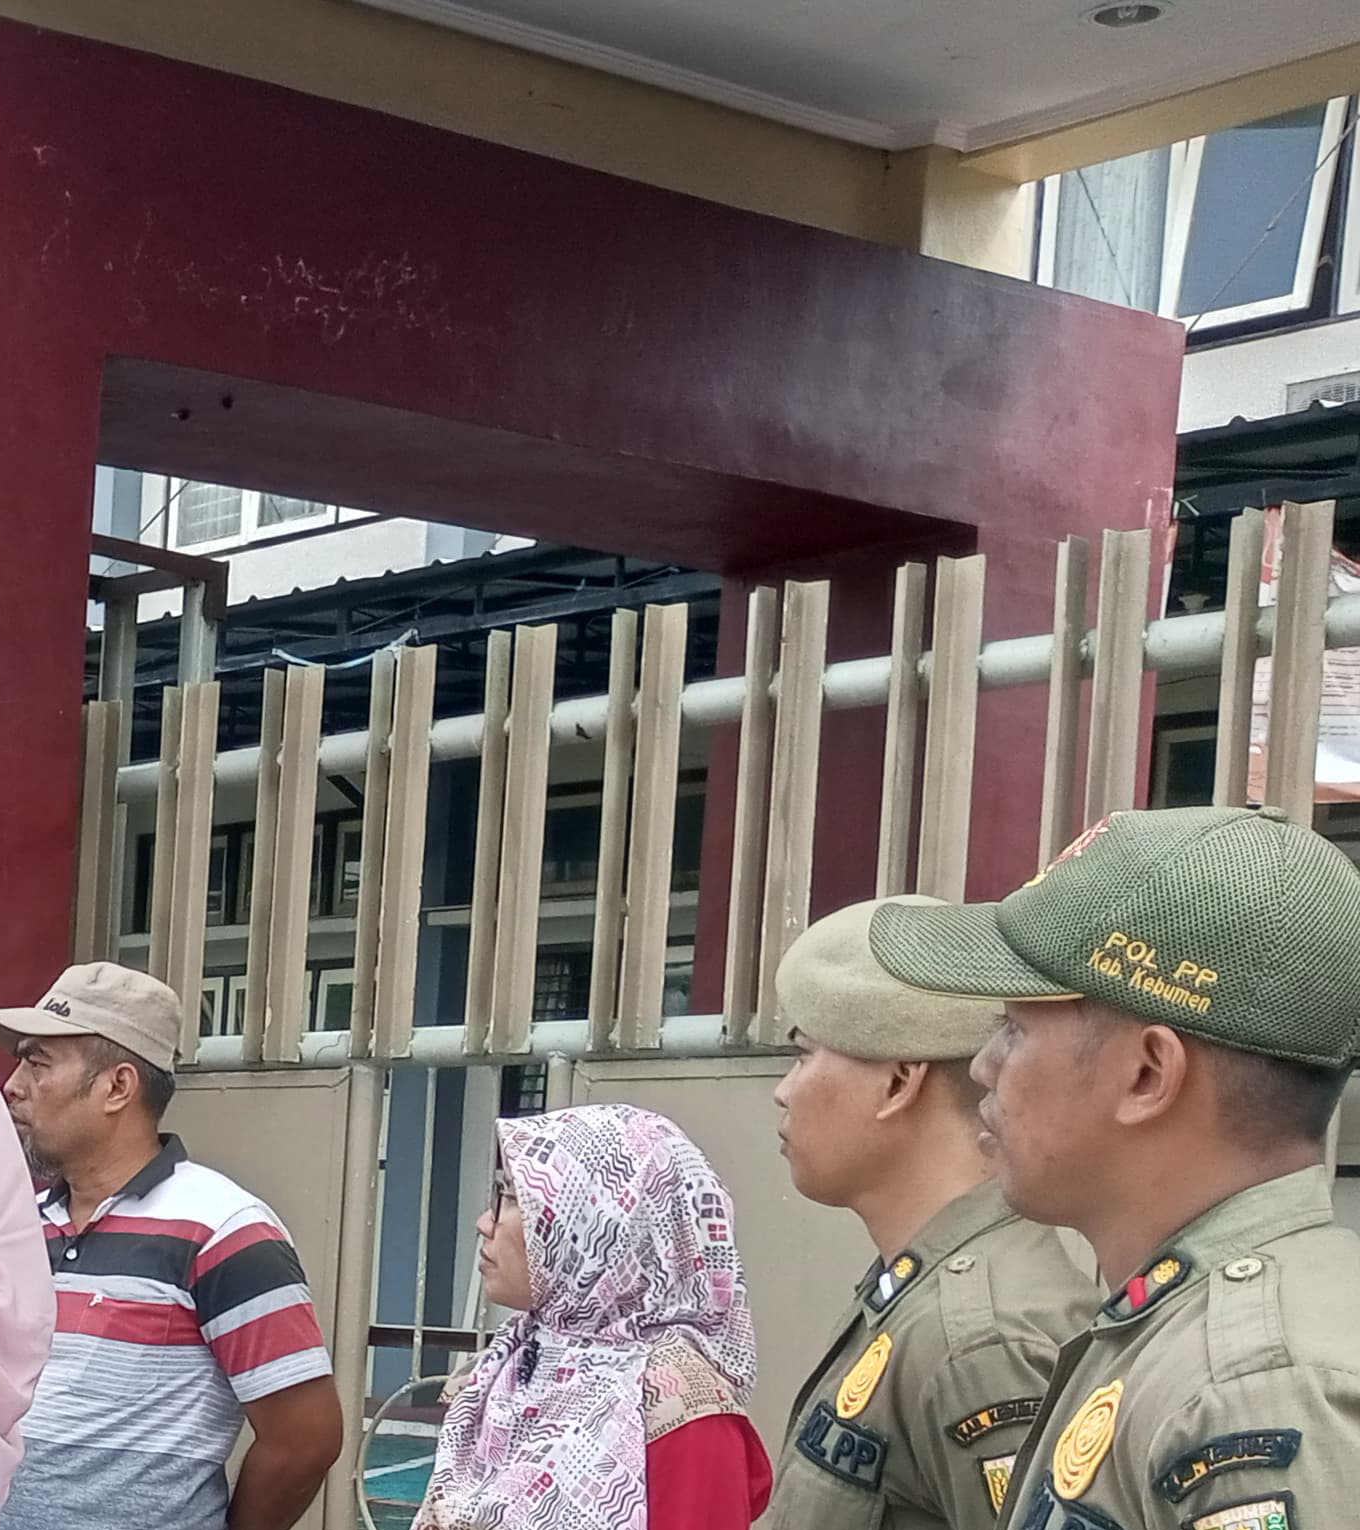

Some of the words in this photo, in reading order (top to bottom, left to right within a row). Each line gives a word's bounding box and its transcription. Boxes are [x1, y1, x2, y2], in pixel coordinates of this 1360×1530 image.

[1086, 947, 1123, 979] Kab.
[1128, 966, 1212, 1014] Kebumen
[1105, 931, 1158, 969] POL
[1173, 960, 1219, 987] PP
